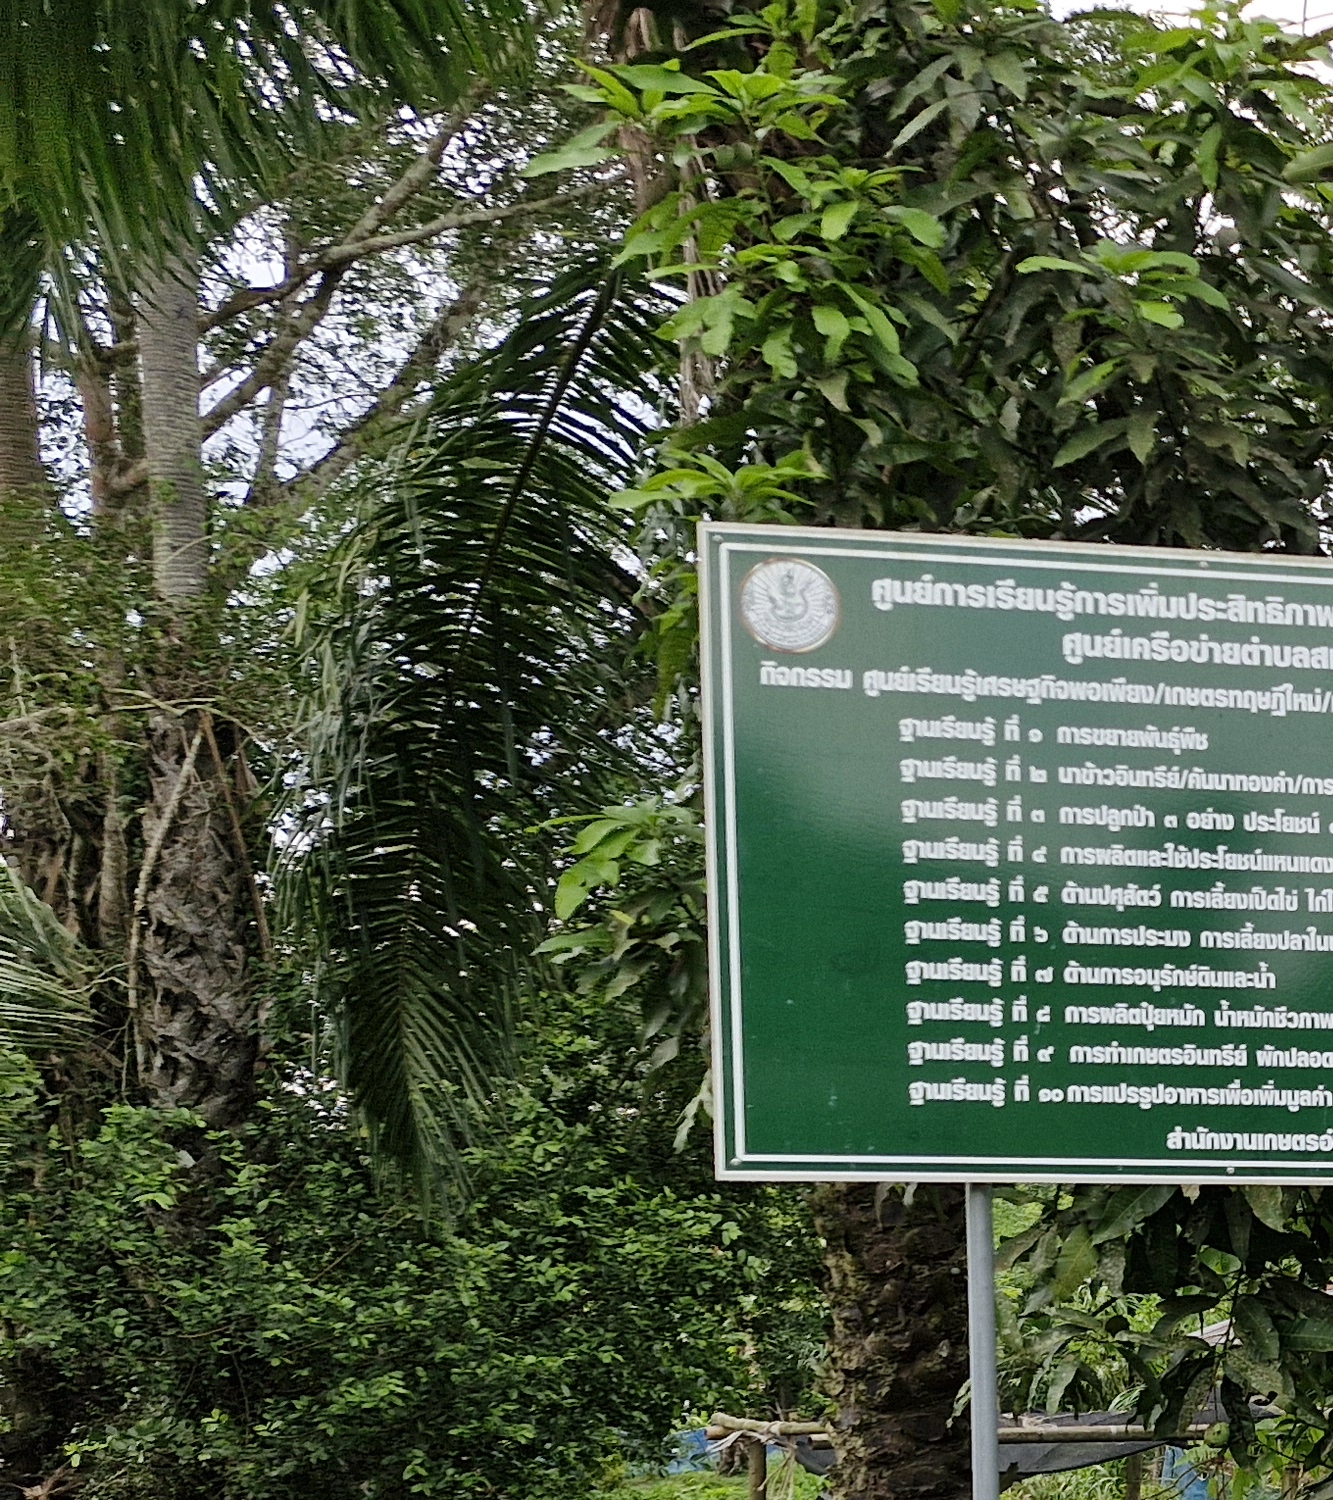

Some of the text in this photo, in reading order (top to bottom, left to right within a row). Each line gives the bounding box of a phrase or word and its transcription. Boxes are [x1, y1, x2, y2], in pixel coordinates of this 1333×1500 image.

[759, 660, 853, 689] กิจกรรม
[898, 714, 1209, 756] ฐานเรียนรู้ ที่ ๑ การขยายพันธุ์พืช
[899, 755, 998, 787] ฐานเรียนรู้
[1004, 754, 1021, 781] ที่
[1028, 765, 1047, 783] ๒
[900, 795, 999, 827] ฐานเรียนรู้
[1005, 795, 1023, 822] ที่
[1030, 809, 1045, 823] ๓
[1058, 804, 1155, 832] การปลูกป่า
[1163, 814, 1178, 828] ๓
[1185, 807, 1235, 831] อย่าง
[1243, 807, 1320, 834] ประโยชน์
[901, 836, 1000, 867] ฐานเรียนรู้
[1006, 834, 1024, 862] ที่
[1031, 845, 1047, 863] ๔
[902, 876, 1001, 908] ฐานเรียนรู้
[1007, 875, 1025, 902] ที่
[1032, 885, 1049, 903] ๕
[1060, 880, 1162, 912] ด้านปศุสัตว์
[1169, 881, 1298, 911] การเลี้ยงเป็ดไข่
[903, 916, 1003, 948] ฐานเรียนรู้
[1008, 915, 1026, 942] ที่
[1032, 925, 1048, 943] ๖
[1061, 920, 1191, 947] ด้านการประมง
[904, 955, 1276, 992] ฐานเรียนรู้ ที่ ๗ ด้านการอนุรักษ์ดินและน้ำ
[905, 996, 1005, 1027] ฐานเรียนรู้
[1011, 995, 1028, 1022] ที่
[1063, 1000, 1206, 1032] การผลิตปุ๋ยหมัก
[907, 1036, 1006, 1068] ฐานเรียนรู้
[1012, 1035, 1029, 1062] ที่
[1036, 1045, 1055, 1063] ๙
[1068, 1040, 1248, 1067] การทำเกษตรอินทรีย์
[908, 1074, 1333, 1112] ฐานเรียนรู้ ที่ ๑๐ การแปรรูปอาหารเพื่อเพิ่มมูลค่า
